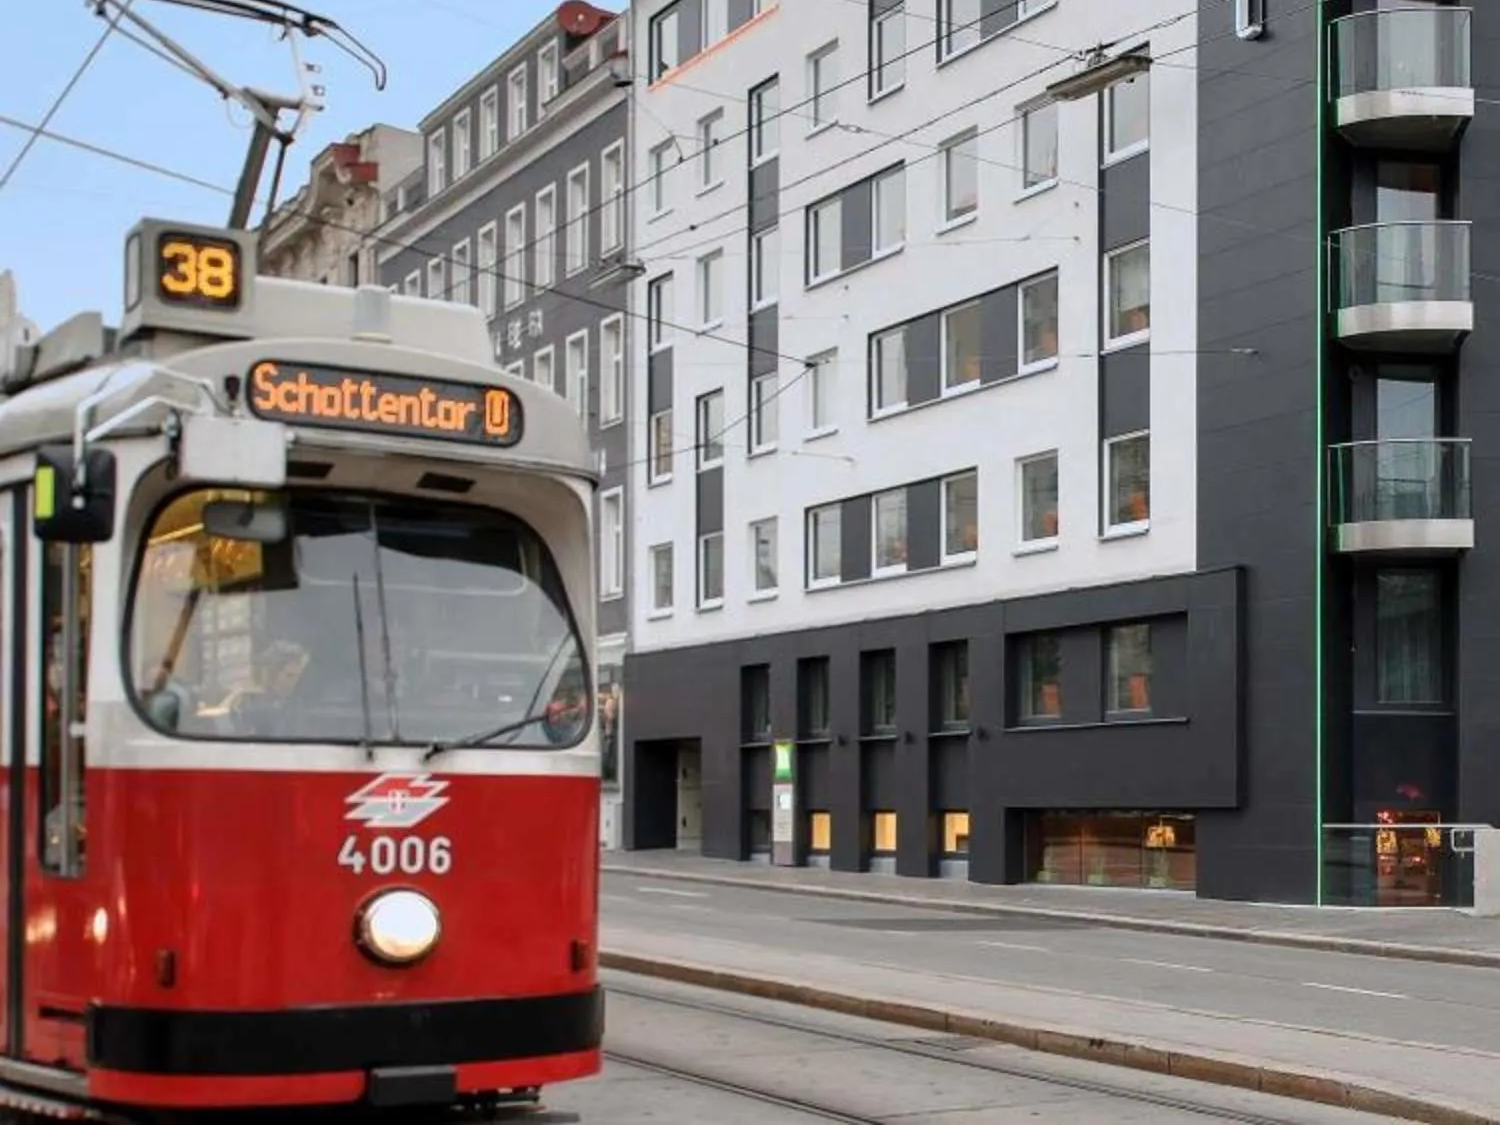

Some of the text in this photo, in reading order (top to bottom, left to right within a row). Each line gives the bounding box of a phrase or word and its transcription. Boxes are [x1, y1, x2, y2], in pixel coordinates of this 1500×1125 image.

[161, 242, 234, 298] 38
[253, 362, 475, 431] Schottentor
[337, 835, 452, 875] 4006
